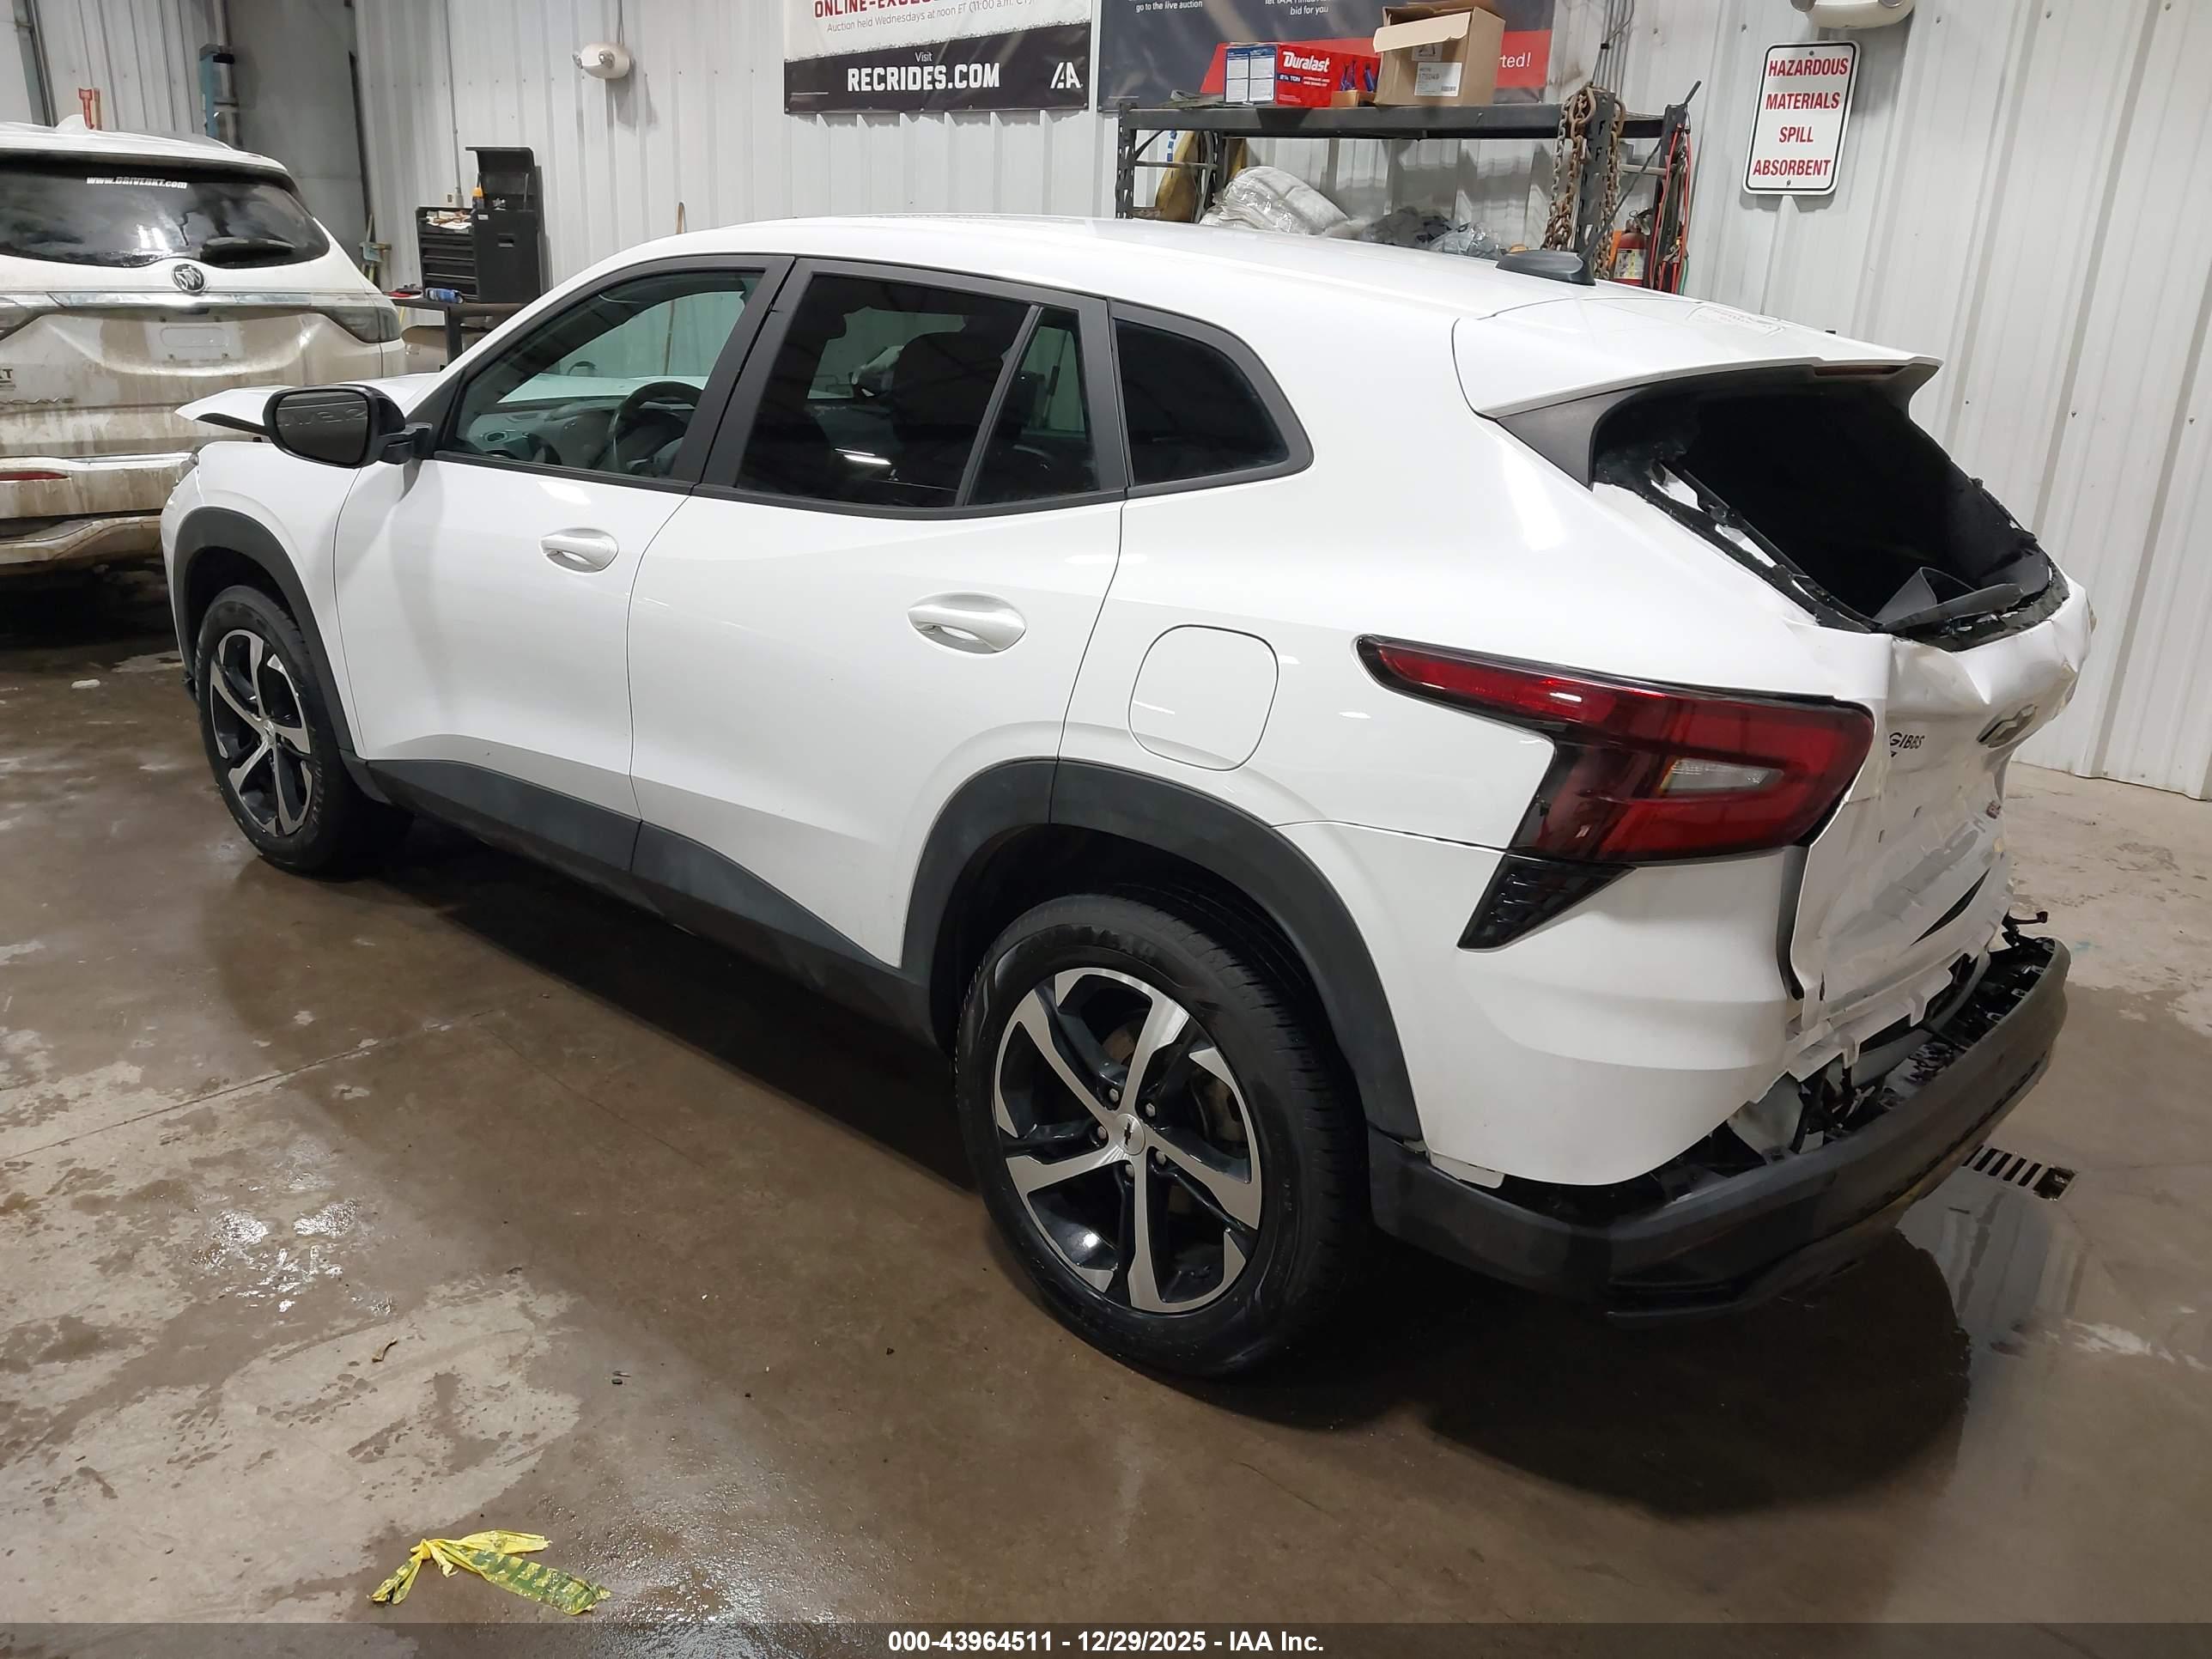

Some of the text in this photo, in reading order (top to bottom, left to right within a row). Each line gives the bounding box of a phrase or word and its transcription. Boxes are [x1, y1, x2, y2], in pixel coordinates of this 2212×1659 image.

[1135, 4, 1144, 13] go
[1164, 0, 1177, 9] live
[1179, 0, 1203, 9] auction
[1290, 5, 1328, 15] bid for you
[827, 21, 855, 32] Auction
[857, 17, 873, 28] held
[875, 10, 926, 25] Wednesdays
[927, 9, 935, 19] at
[936, 6, 956, 17] noon
[957, 3, 967, 14] ET
[915, 51, 933, 63] Visit
[1282, 51, 1330, 73] Duralast
[1767, 58, 1849, 77] HAZARDOUS
[847, 62, 1000, 92] RECRIDES.COM
[1765, 92, 1841, 110] MATERIALS
[1778, 125, 1814, 143] SPILL
[1753, 159, 1832, 177] ABSORBENT
